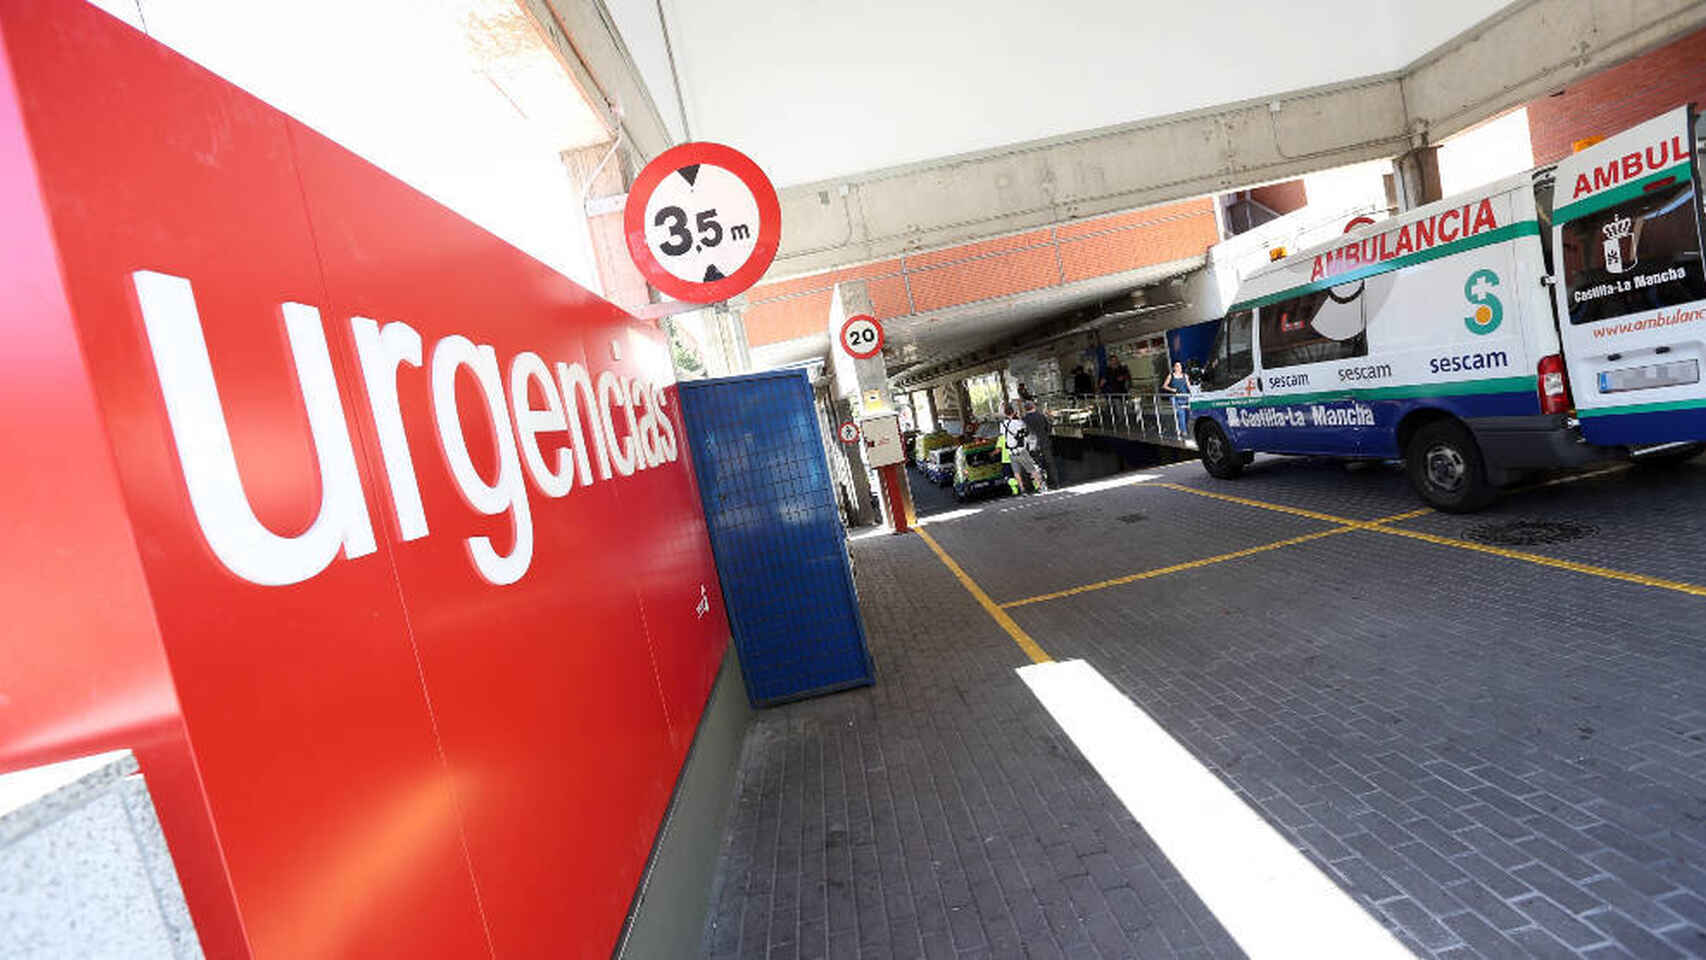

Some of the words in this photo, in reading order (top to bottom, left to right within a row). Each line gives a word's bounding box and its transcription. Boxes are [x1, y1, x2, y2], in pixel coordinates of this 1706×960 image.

[1573, 136, 1690, 199] AMBUL
[731, 224, 750, 241] m
[1311, 198, 1497, 282] AMBULANCIA
[1574, 279, 1632, 303] Castilla-La
[1633, 267, 1687, 289] Mancha
[850, 328, 875, 346] 20
[1338, 363, 1392, 382] sescam
[1429, 350, 1508, 374] sescam
[1269, 373, 1310, 388] sescam
[1311, 402, 1376, 427] Mancha
[133, 269, 678, 586] urgencias
